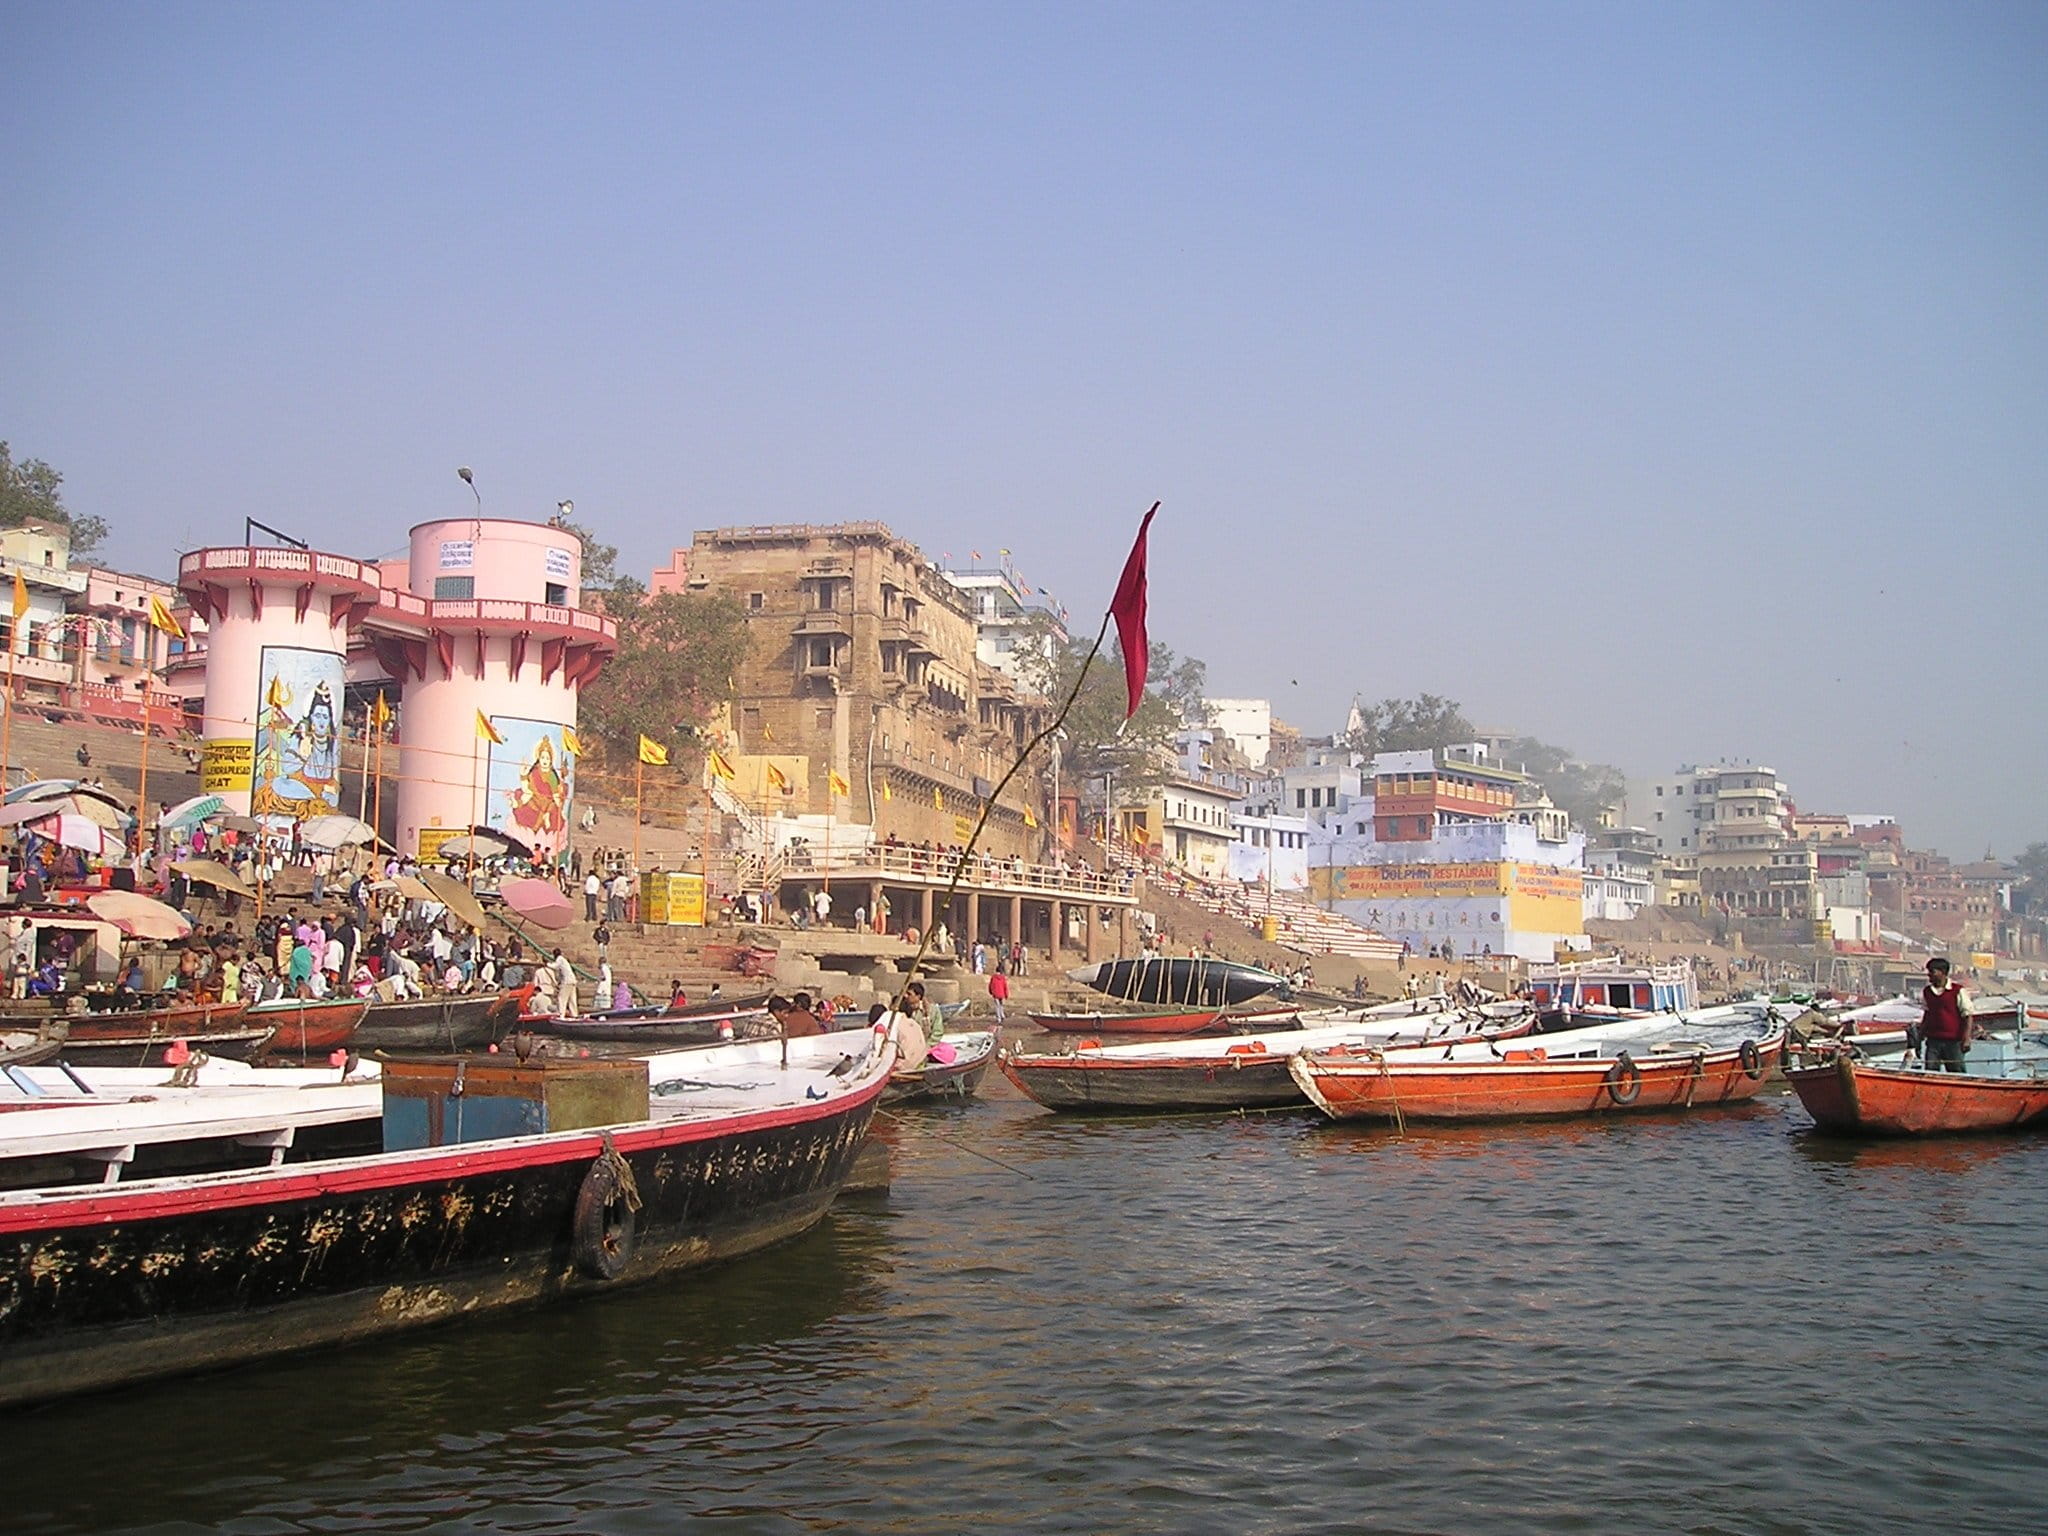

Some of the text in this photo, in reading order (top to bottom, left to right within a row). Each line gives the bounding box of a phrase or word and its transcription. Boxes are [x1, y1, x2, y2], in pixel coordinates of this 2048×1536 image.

[205, 777, 232, 788] GHAT
[1381, 868, 1431, 881] DOLPHIN
[1433, 866, 1498, 880] RESTAURANT
